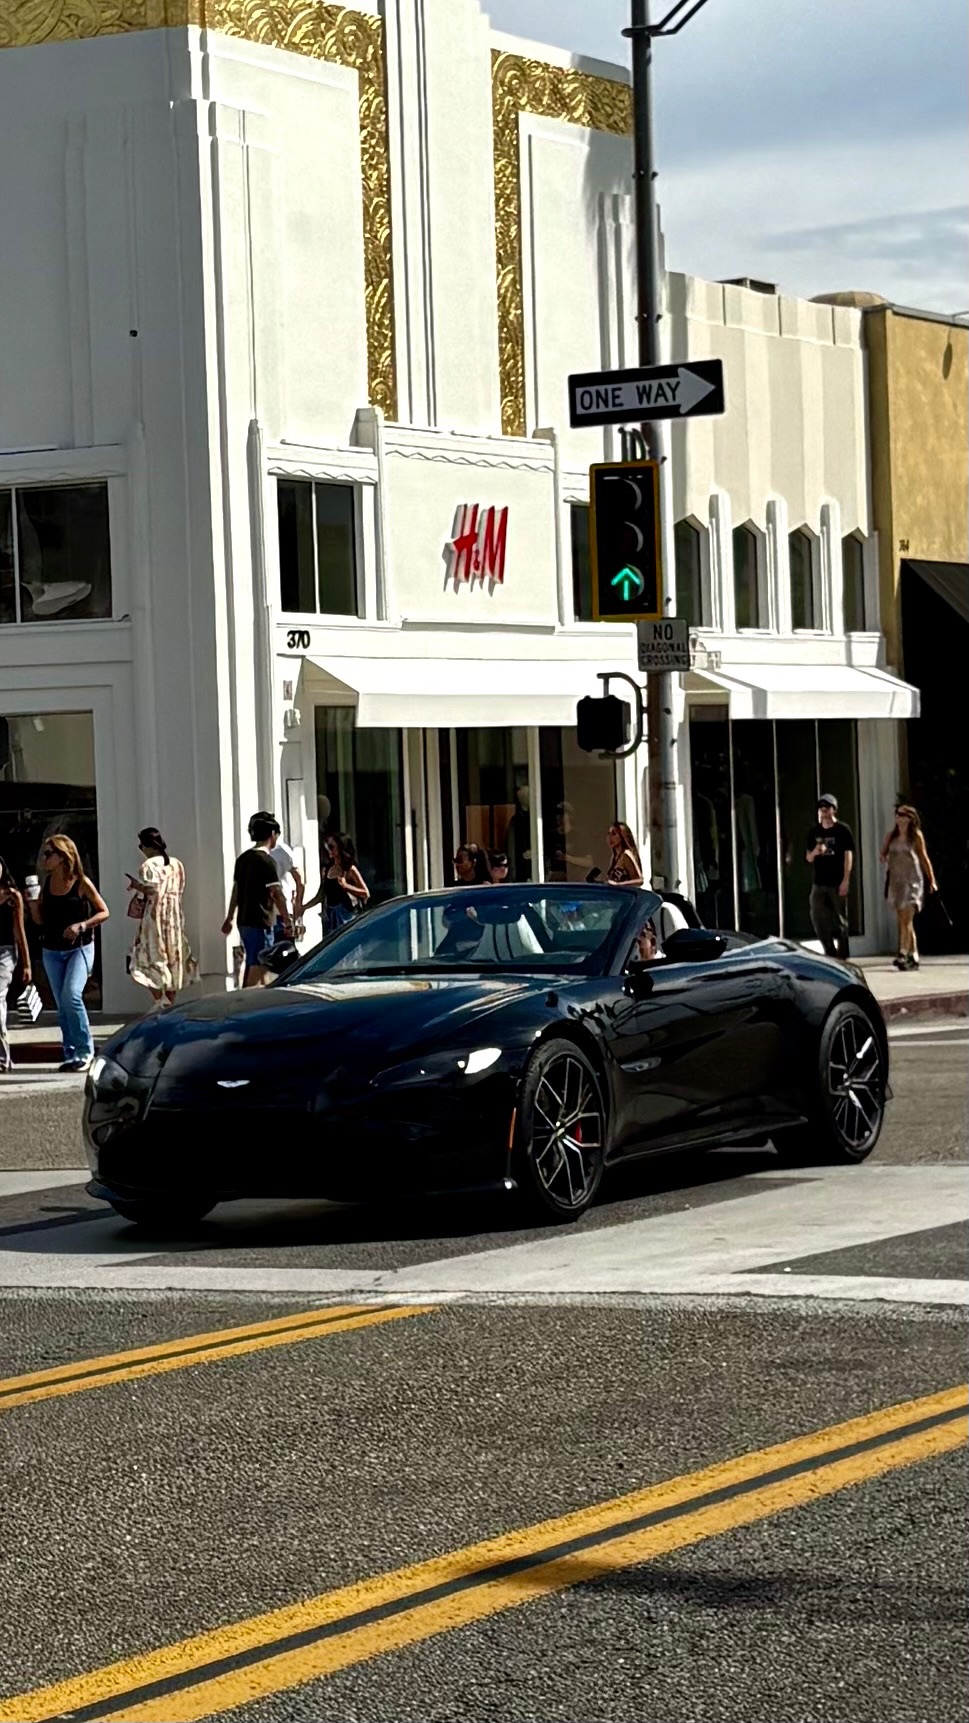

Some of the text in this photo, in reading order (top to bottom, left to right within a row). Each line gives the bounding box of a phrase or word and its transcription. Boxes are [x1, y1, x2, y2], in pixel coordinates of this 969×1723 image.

[580, 380, 680, 411] ONE WAY
[453, 503, 509, 585] H&M
[287, 629, 311, 649] 370
[653, 623, 673, 640] NO
[641, 642, 687, 653] DIAGONAL
[641, 654, 687, 666] CROSSING
